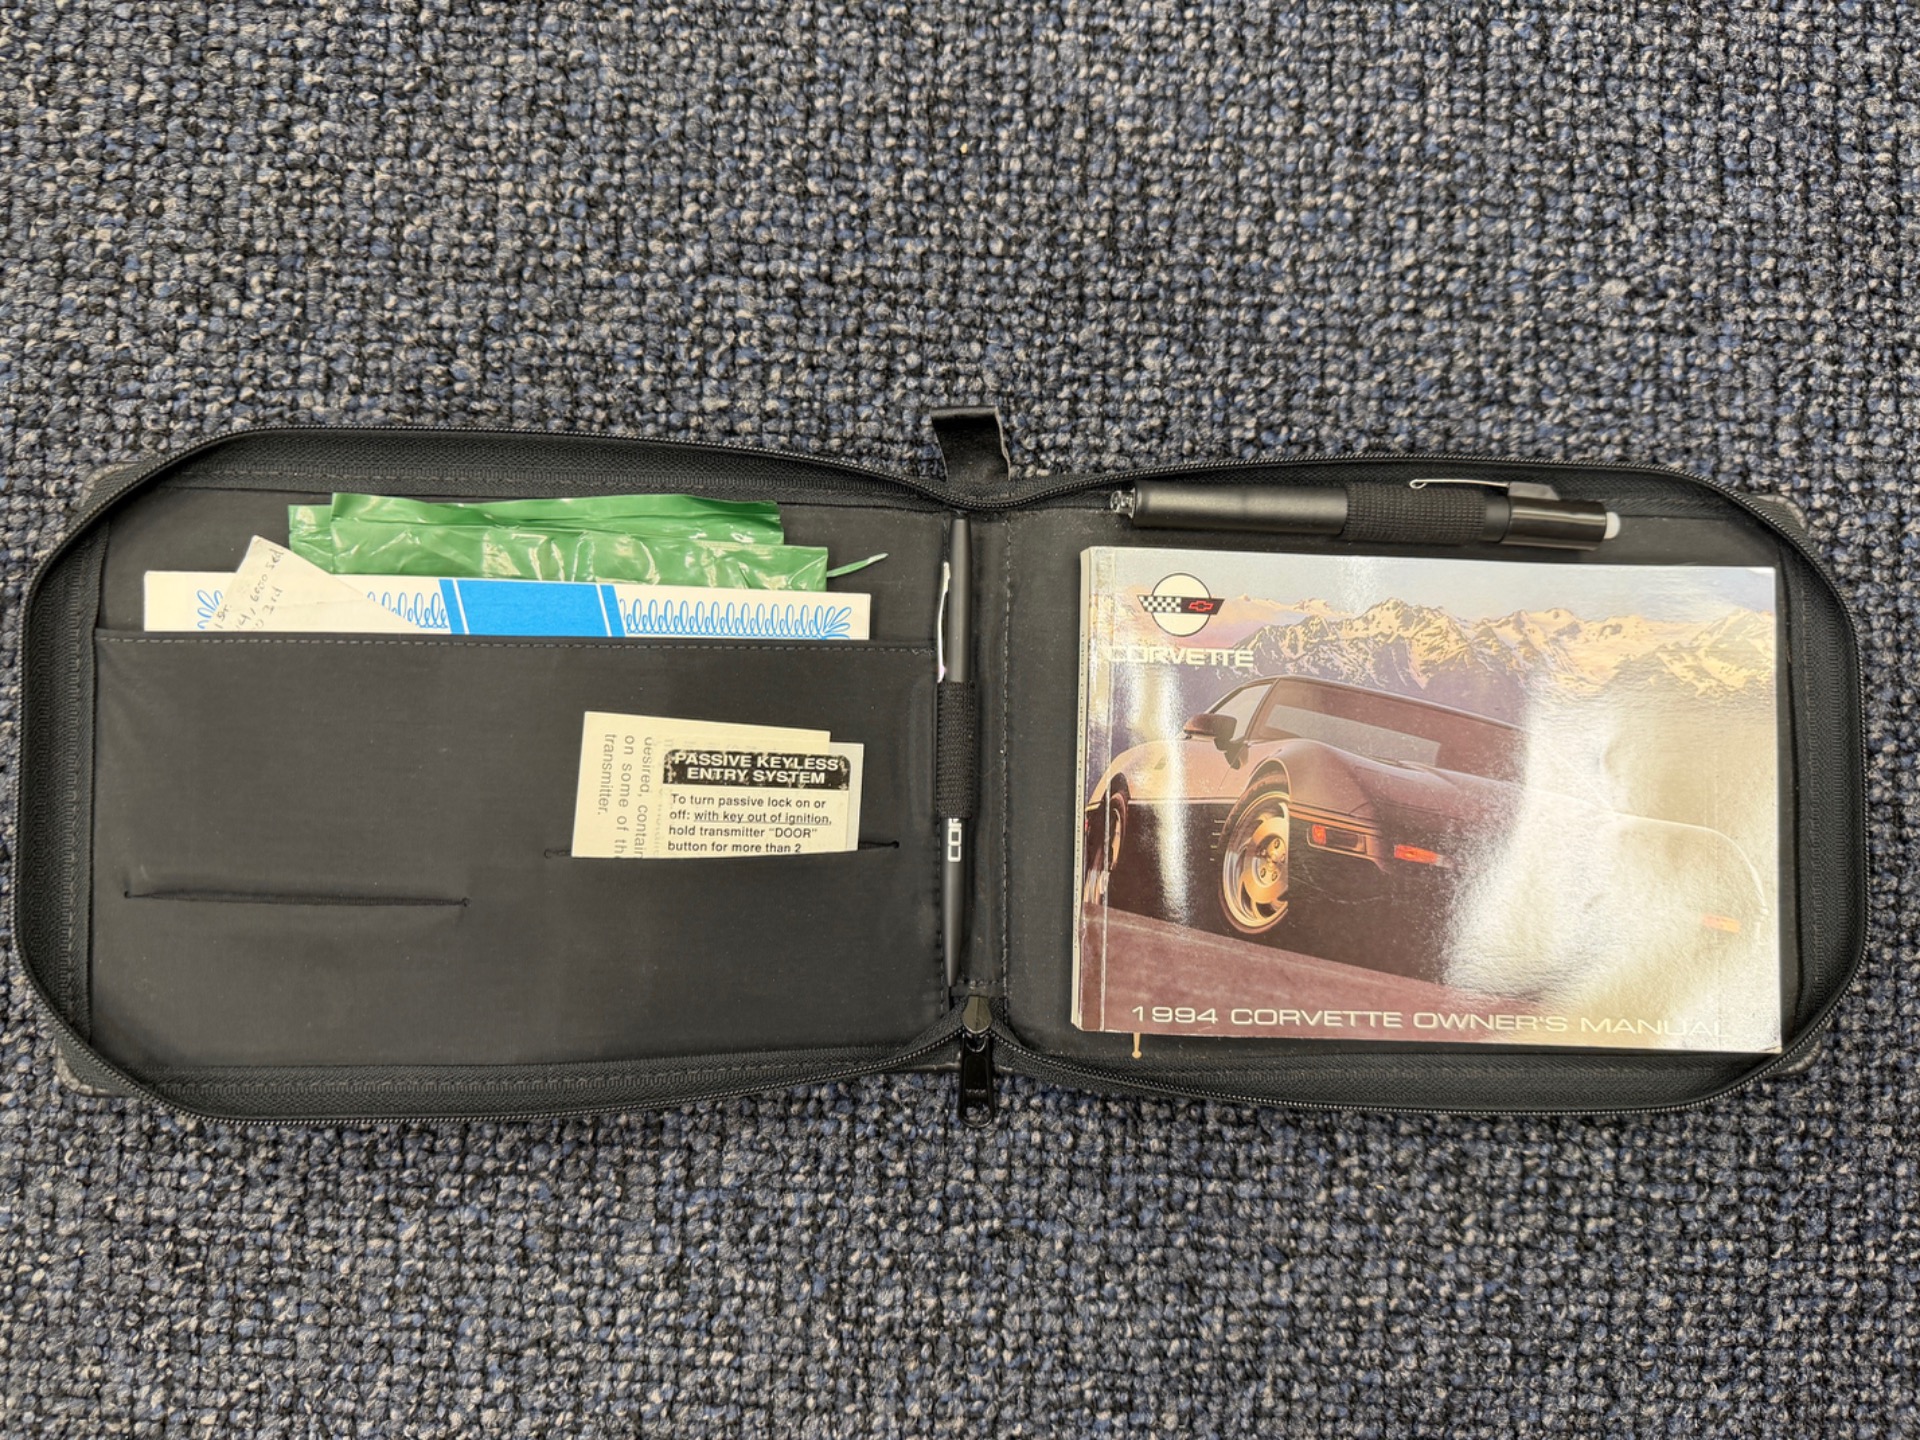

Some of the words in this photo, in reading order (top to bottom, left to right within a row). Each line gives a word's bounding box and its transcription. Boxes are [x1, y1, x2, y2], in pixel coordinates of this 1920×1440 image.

[1108, 646, 1254, 668] CORVETTE
[624, 735, 635, 755] on
[674, 752, 752, 768] PASSIVE
[757, 755, 839, 771] KEYLESS
[597, 733, 617, 815] transmitter.
[687, 767, 748, 781] ENTRY
[752, 770, 825, 784] SYSTEM
[618, 763, 632, 807] some
[671, 793, 686, 805] To
[690, 795, 715, 805] turn
[718, 796, 764, 808] passive
[767, 797, 792, 808] lock
[795, 800, 810, 808] on
[814, 801, 826, 809] or
[616, 815, 629, 831] of
[669, 810, 690, 820] off:
[694, 810, 719, 821] with
[723, 811, 744, 823] key
[747, 813, 766, 823] out
[770, 812, 782, 823] of
[785, 813, 832, 826] ignition,
[669, 826, 695, 836] hold
[699, 826, 765, 838] transmitter
[614, 839, 627, 858] th
[667, 841, 707, 851] button
[711, 841, 727, 851] for
[731, 844, 762, 853] more
[765, 843, 791, 853] than
[795, 844, 802, 853] 2
[1131, 1005, 1218, 1024] 1994
[1230, 1008, 1404, 1029] CORVETTE
[1413, 1012, 1568, 1033] OWNER'S
[1580, 1016, 1731, 1039] MANUAL
